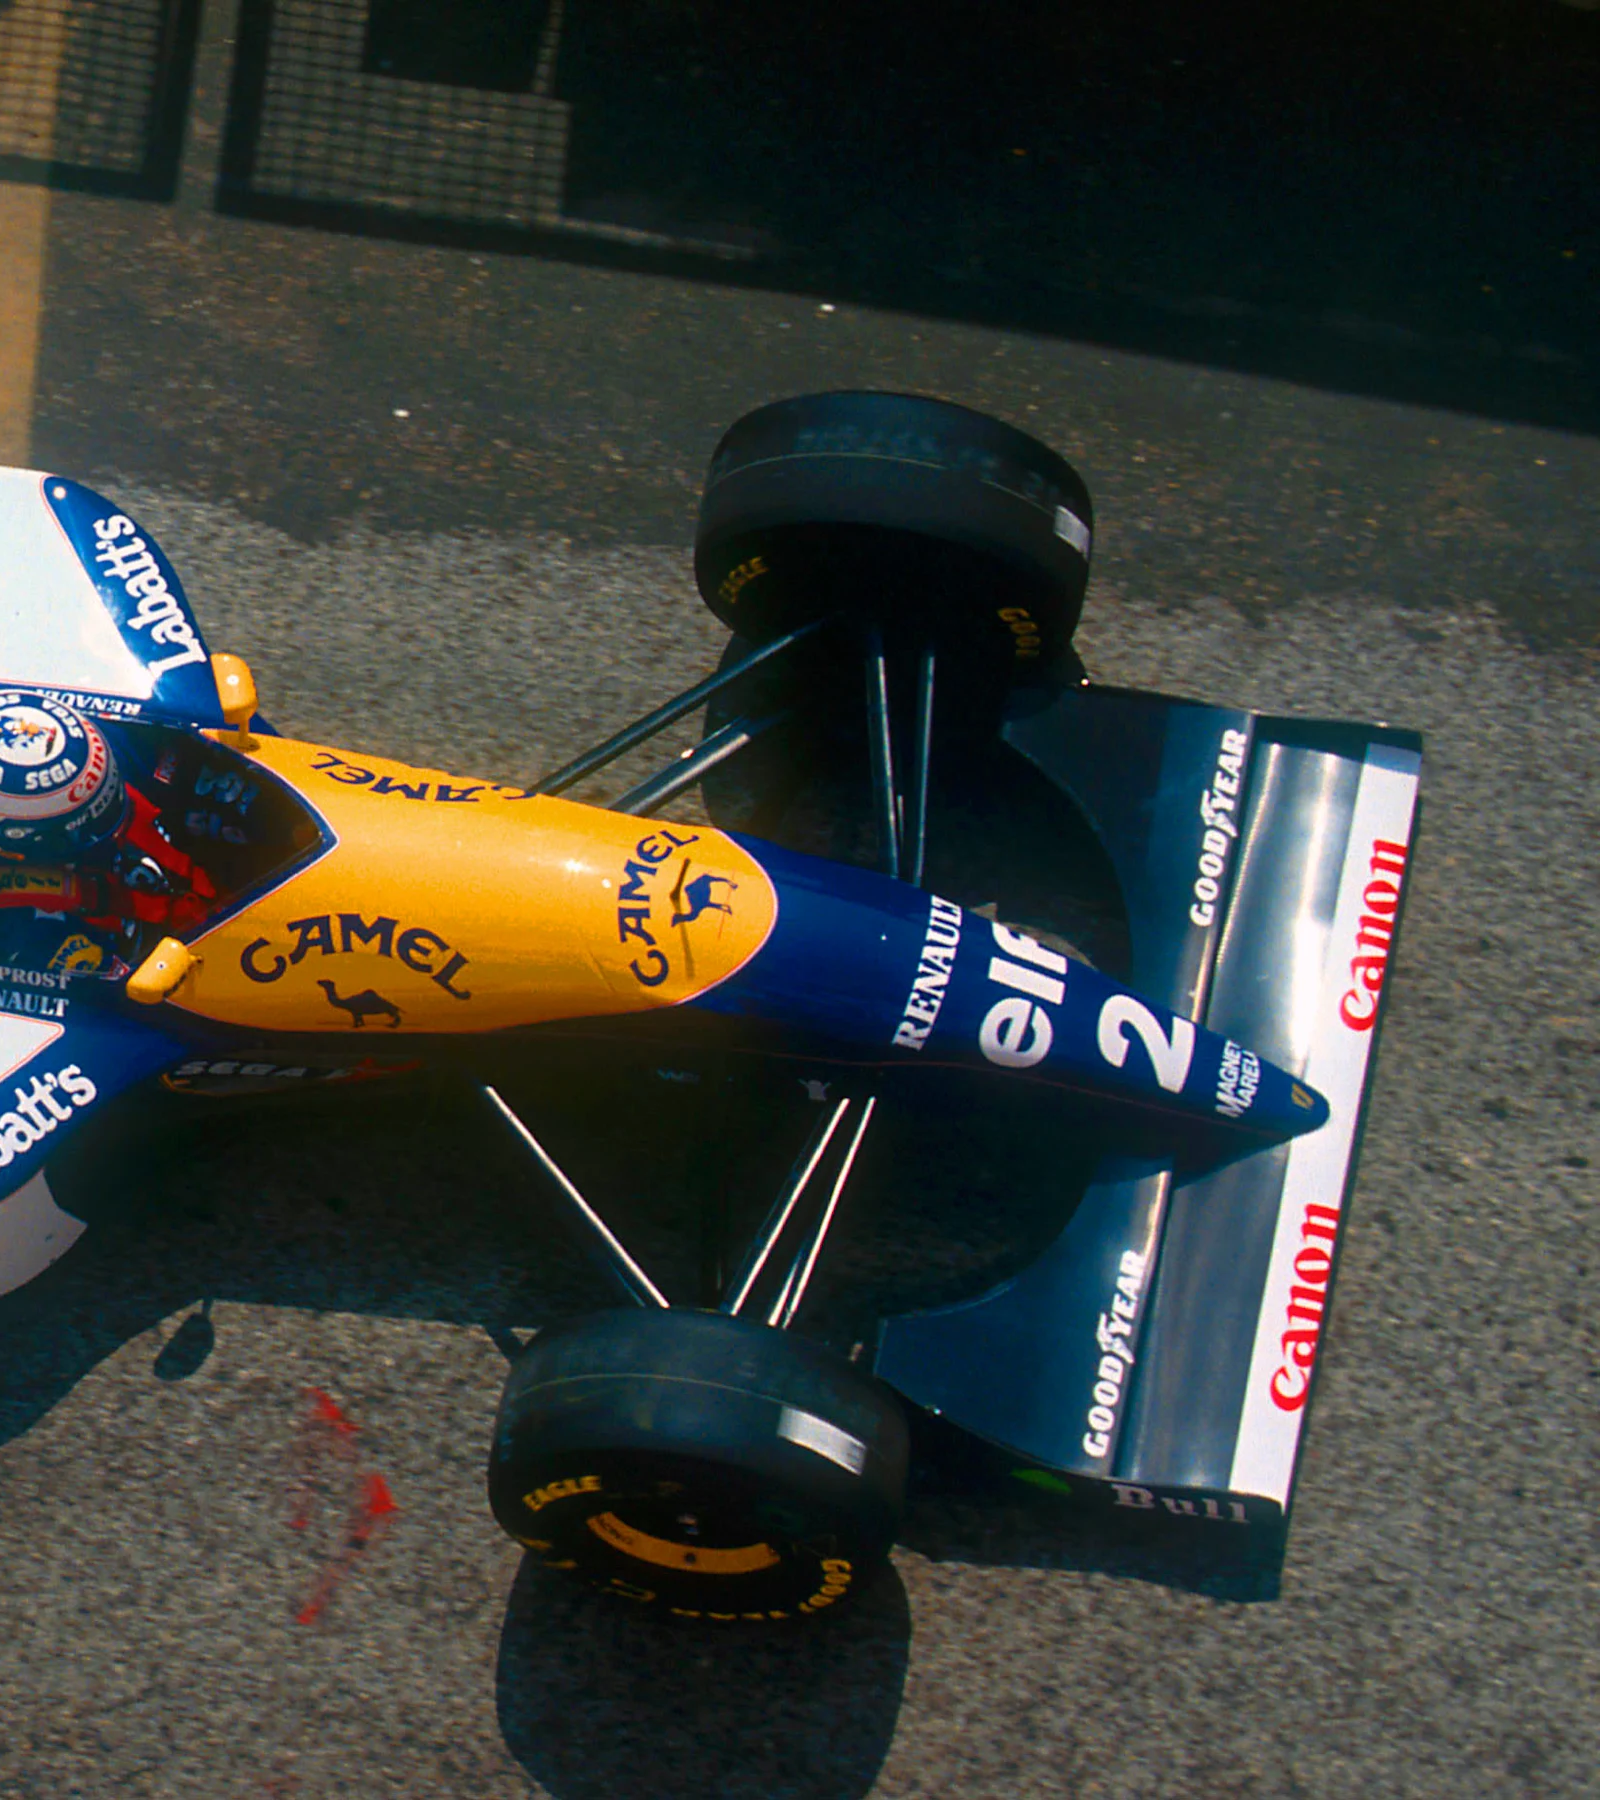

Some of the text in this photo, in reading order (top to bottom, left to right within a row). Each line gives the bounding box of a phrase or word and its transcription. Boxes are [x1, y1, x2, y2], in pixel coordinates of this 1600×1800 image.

[93, 514, 206, 672] Labatt's
[25, 758, 78, 790] SEGA
[1189, 729, 1247, 927] GOODYEAR
[240, 913, 471, 1000] CAMEL
[617, 827, 700, 987] CAMEL
[1339, 839, 1408, 1032] Canon
[980, 922, 1067, 1068] elf
[1097, 995, 1196, 1093] 2
[1215, 1040, 1245, 1117] MAGNET
[1084, 1250, 1147, 1458] GOODYEAR
[1270, 1203, 1341, 1412] Canon
[1110, 1484, 1251, 1523] Bull
